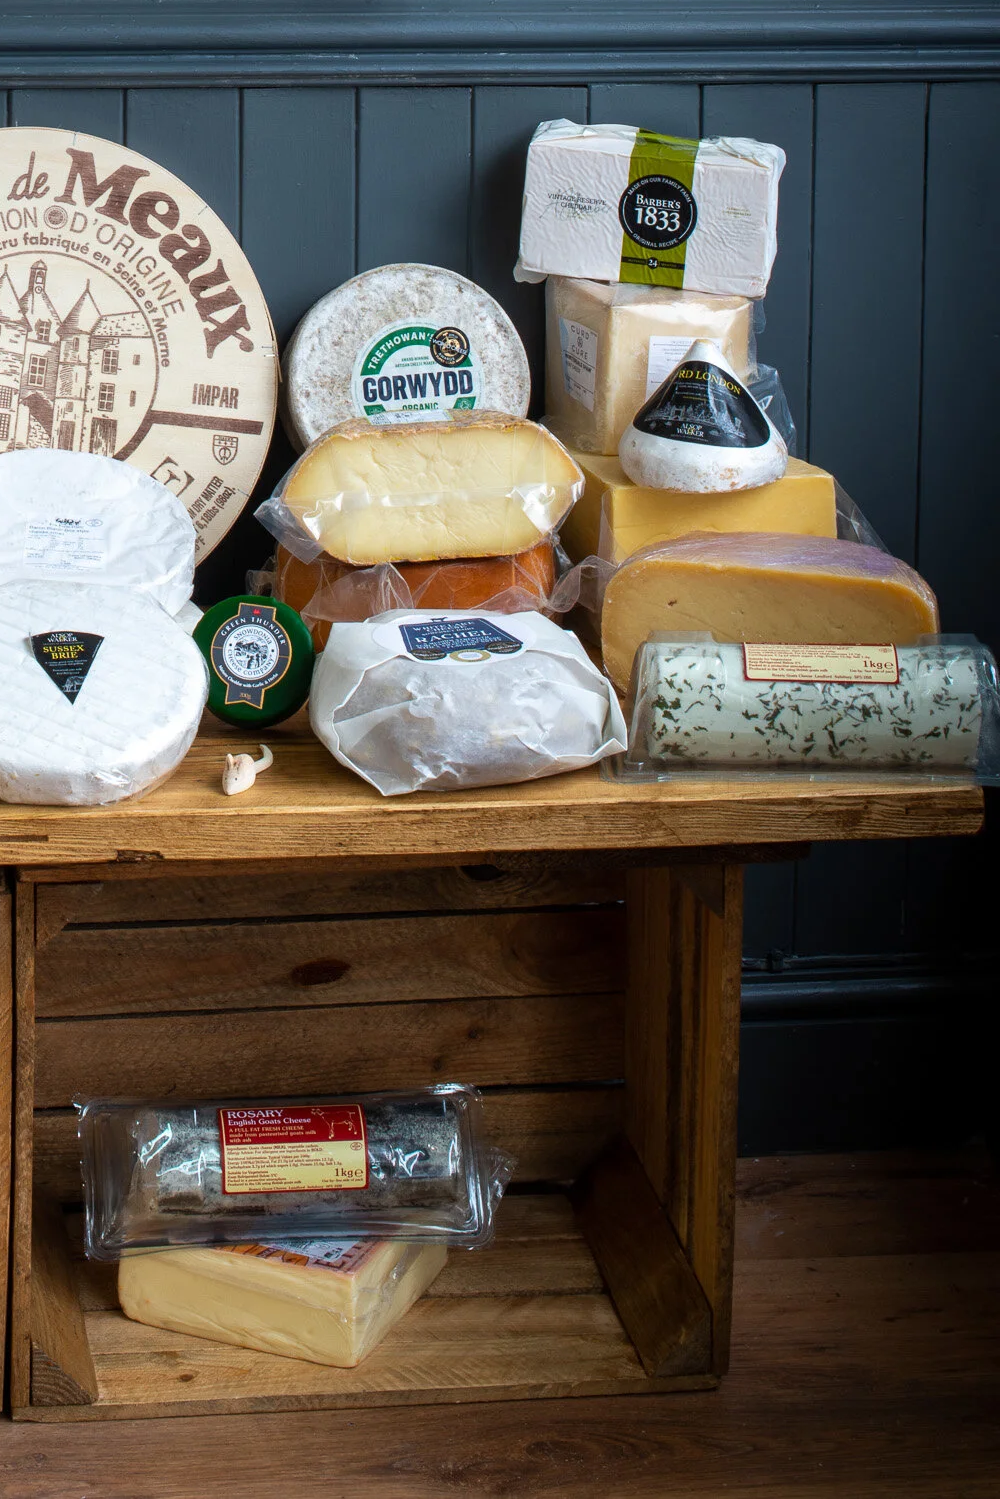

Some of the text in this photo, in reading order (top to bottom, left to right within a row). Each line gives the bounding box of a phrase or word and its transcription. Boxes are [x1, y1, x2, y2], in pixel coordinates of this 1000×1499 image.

[548, 193, 575, 202] VINTAGE
[628, 183, 640, 196] MADE
[662, 178, 681, 190] FAMILY
[679, 188, 692, 202] FARM
[634, 207, 680, 231] 1833
[632, 233, 679, 248] ORIGINAL RECIPE
[7, 151, 50, 201] de
[54, 147, 254, 359] Meaux
[648, 259, 657, 267] 24
[70, 212, 185, 319] D'ORIGINE
[23, 232, 90, 255] fabriqué
[93, 250, 111, 267] en
[112, 260, 146, 298] Seine
[144, 299, 159, 314] et
[152, 317, 170, 368] Marne
[570, 325, 590, 340] CURD
[571, 346, 588, 360] CURE
[362, 369, 473, 402] GORWYDD
[696, 371, 741, 395] LONDON
[192, 383, 239, 409] IMPAR
[193, 476, 224, 515] DRY MATTER
[221, 617, 286, 644] GREEN THUNDER
[415, 630, 491, 643] RACHEL
[227, 1110, 283, 1119] ROSARY
